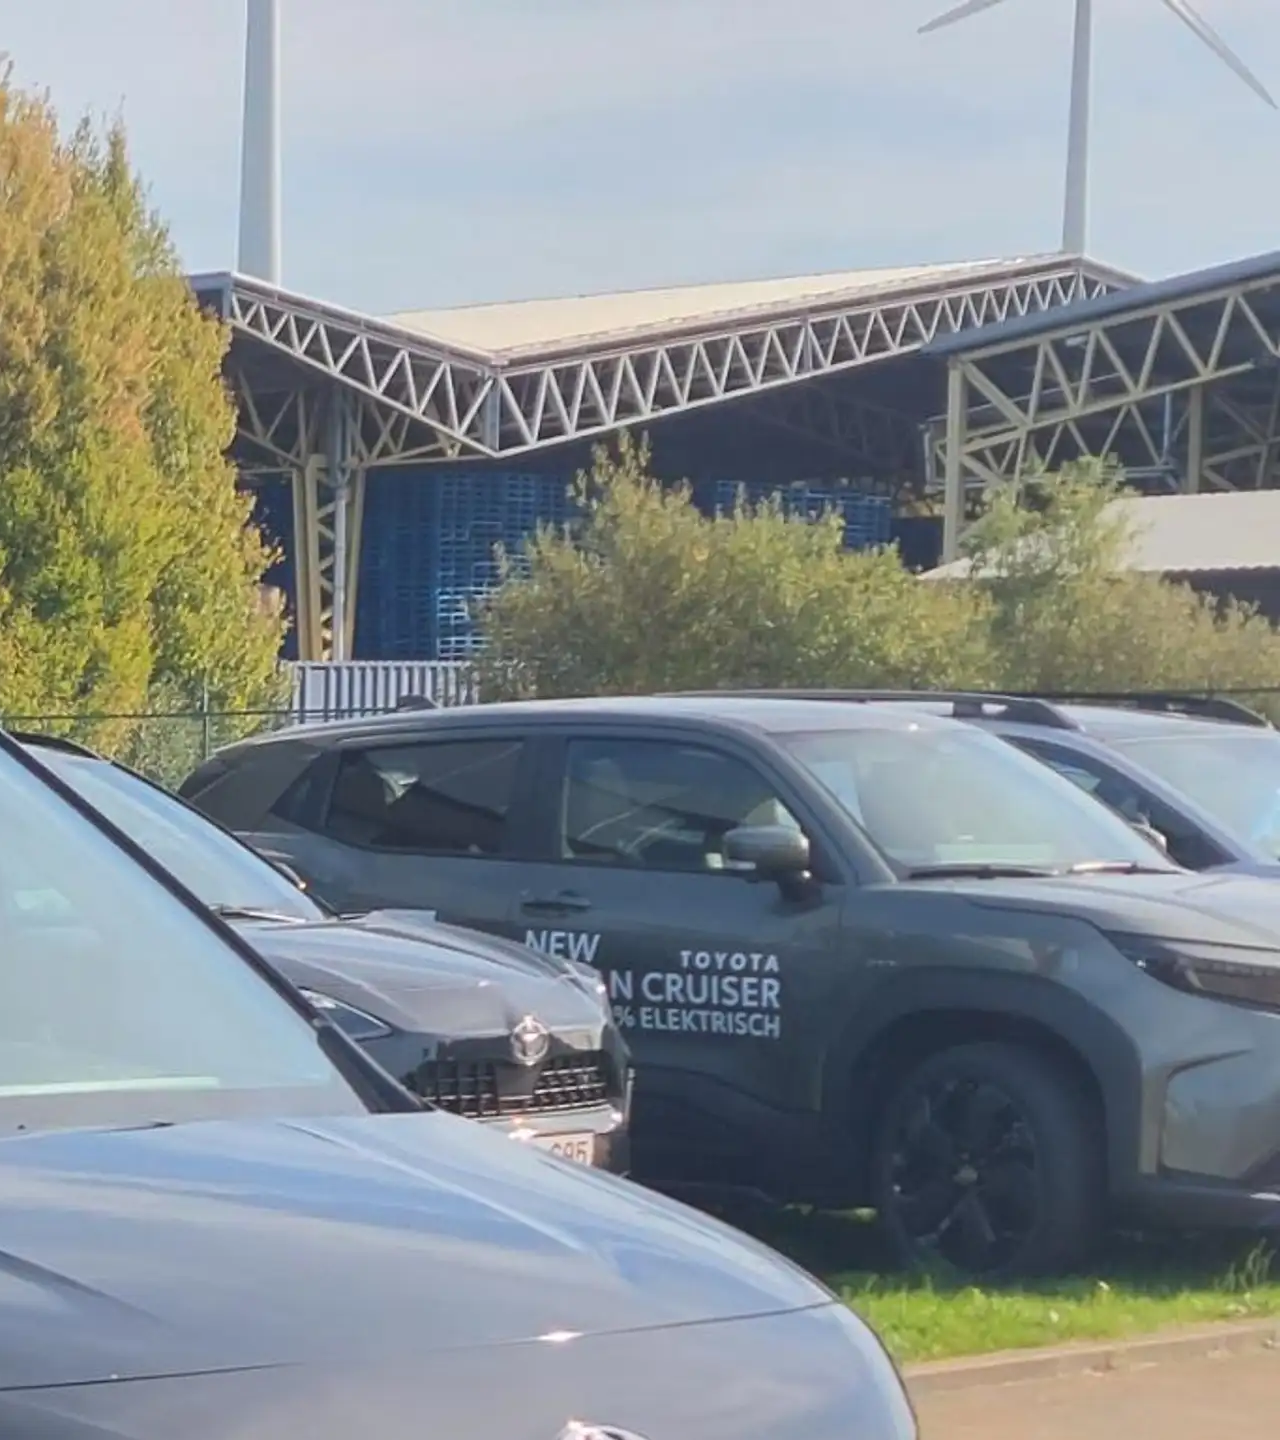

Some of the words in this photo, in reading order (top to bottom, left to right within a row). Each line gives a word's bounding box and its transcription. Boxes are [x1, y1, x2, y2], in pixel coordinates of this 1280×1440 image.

[524, 929, 602, 963] NEW
[679, 950, 780, 973] TOYOTA
[641, 971, 781, 1009] CRUISER
[640, 1006, 781, 1040] ELEKTRISCH
